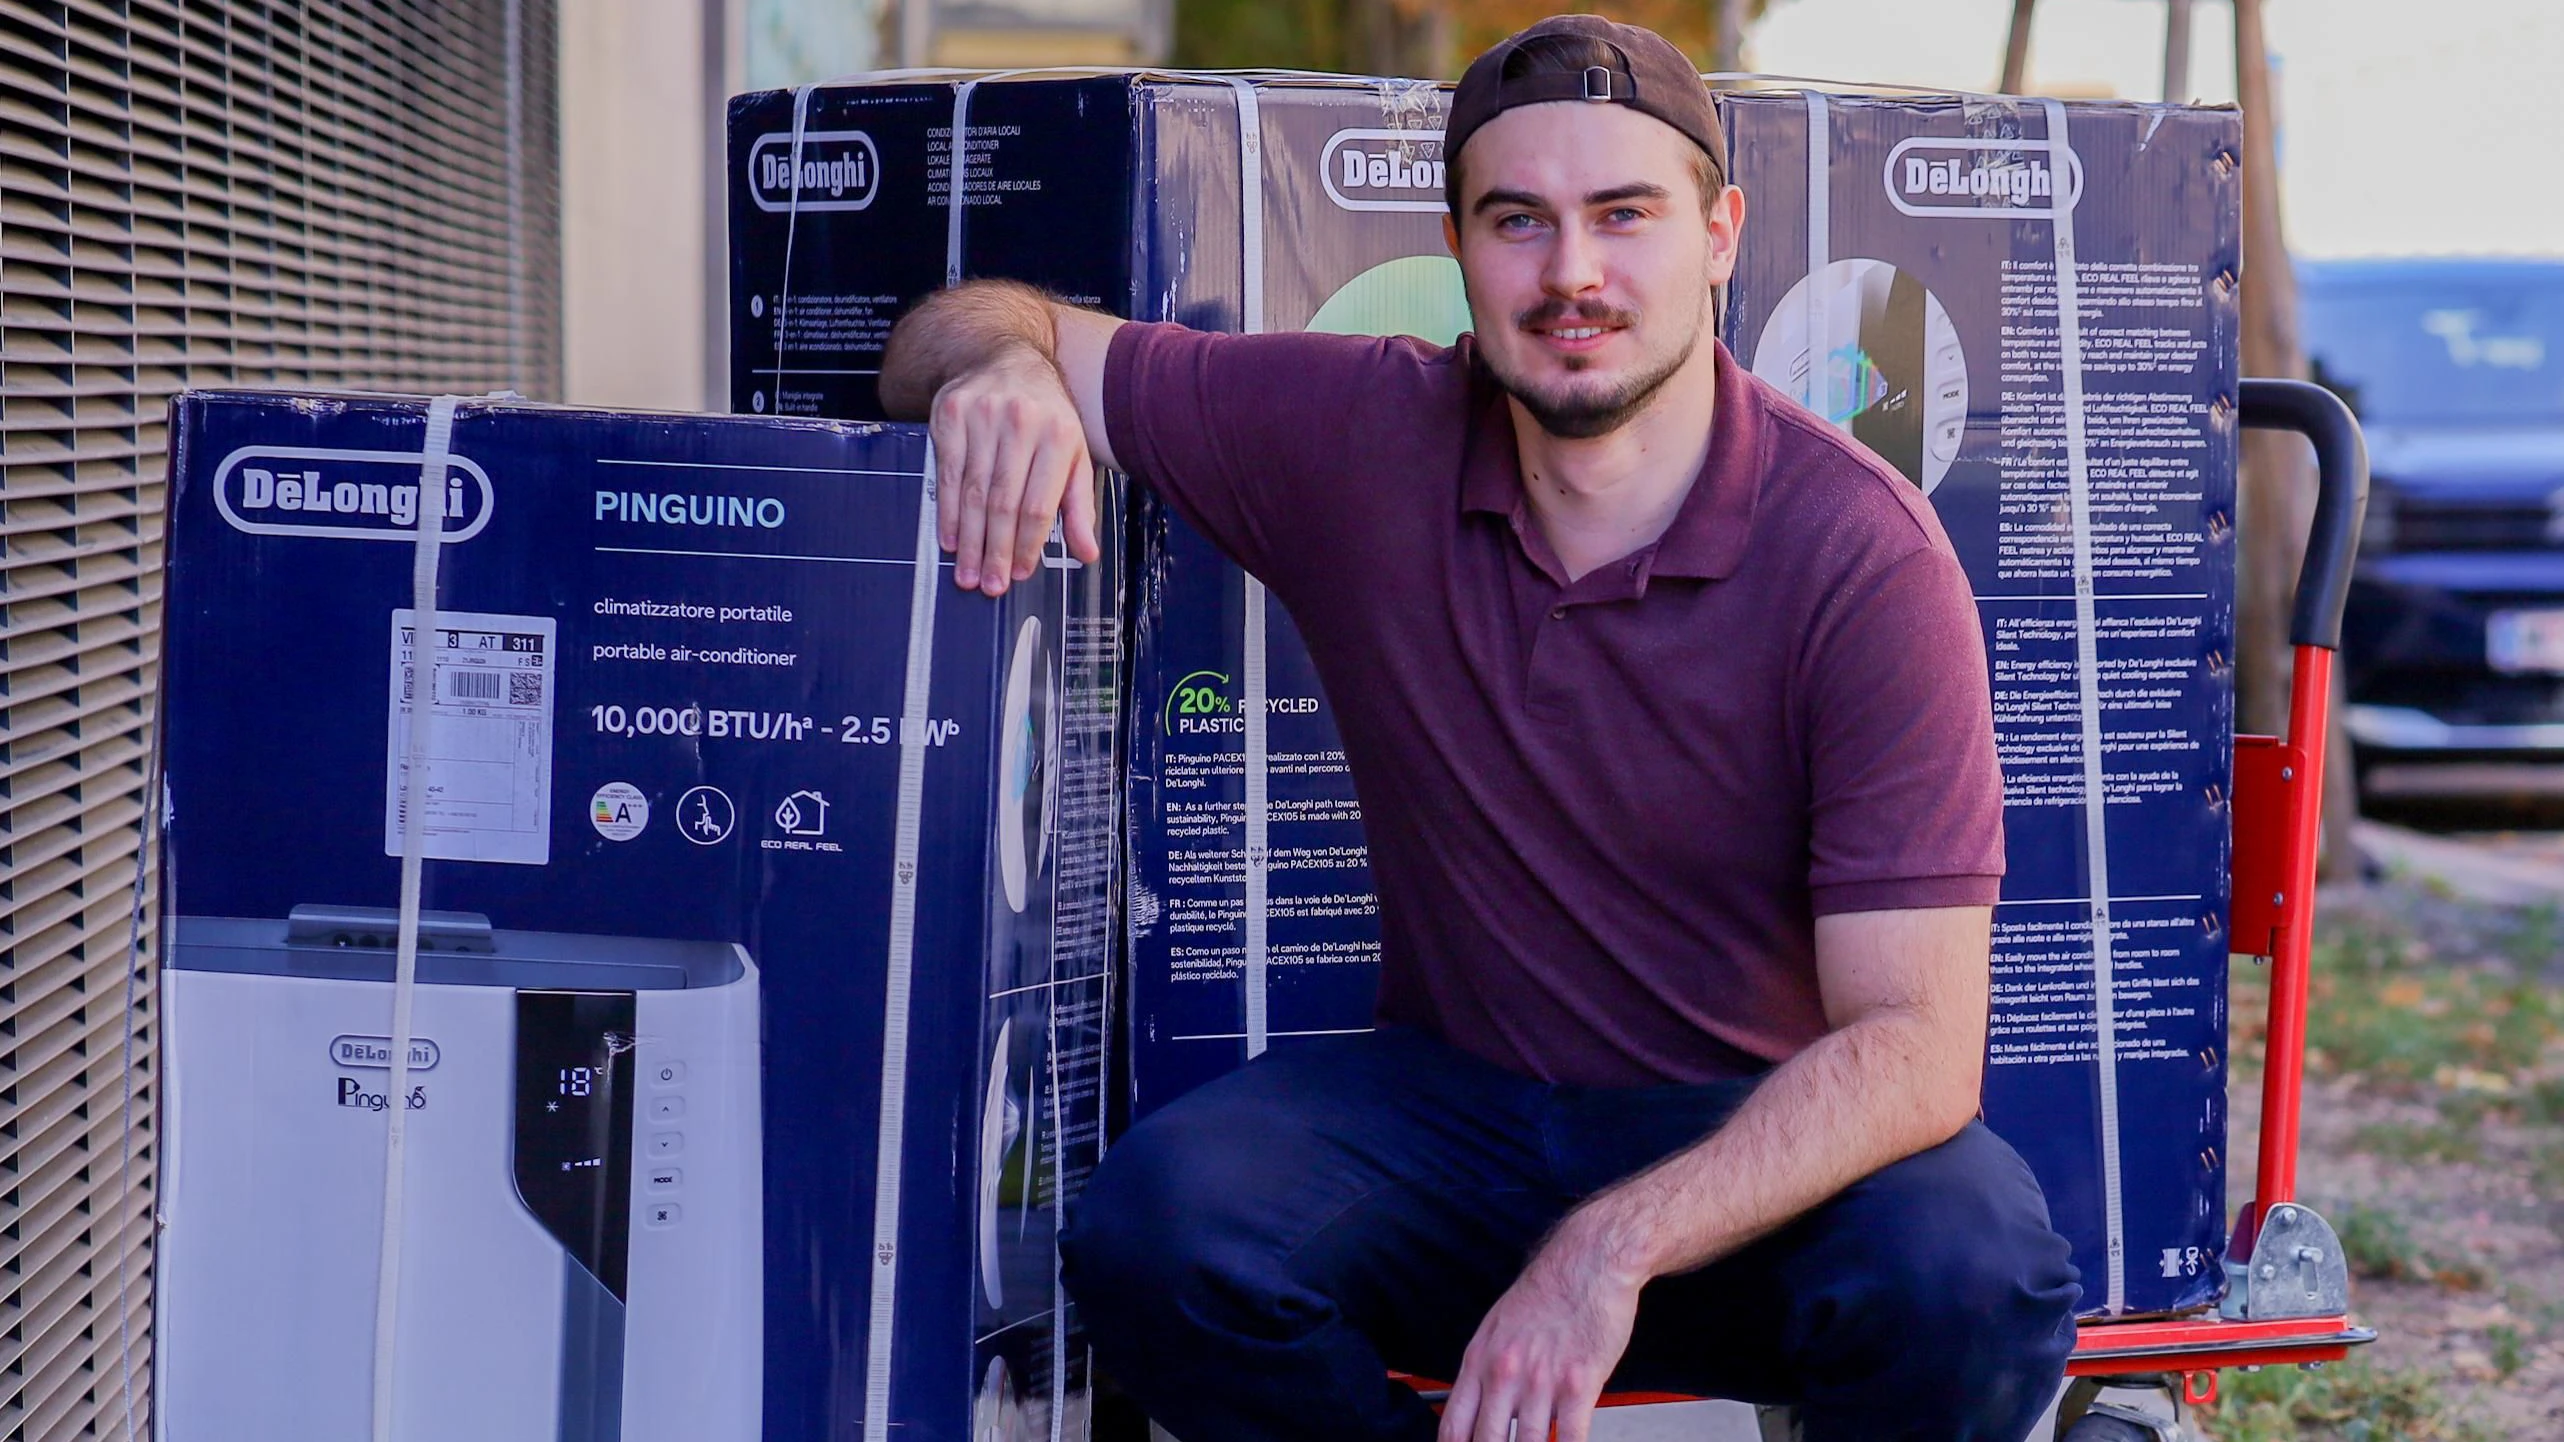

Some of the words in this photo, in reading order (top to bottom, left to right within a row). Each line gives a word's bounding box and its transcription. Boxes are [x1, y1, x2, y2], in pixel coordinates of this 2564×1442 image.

[928, 141, 947, 151] LOCAL
[1013, 180, 1041, 190] LOCALES
[983, 195, 1002, 204] LOCAL
[595, 491, 785, 528] PINGUINO
[594, 598, 715, 619] climatizzatore
[720, 605, 793, 623] portatile
[449, 634, 457, 646] 3
[479, 637, 495, 648] AT
[513, 638, 534, 651] 311
[593, 643, 666, 661] portable
[671, 645, 796, 666] air-conditioner
[1179, 687, 1230, 713] 20%
[592, 704, 702, 738] 10,000
[841, 716, 891, 743] 2.5
[1180, 718, 1245, 733] PLASTIC
[1165, 754, 1177, 763] IT:
[1178, 753, 1212, 764] Pinguino
[1213, 753, 1246, 763] PACEX1
[1304, 753, 1319, 761] con
[1326, 751, 1345, 761] 20%
[1165, 766, 1198, 776] riciclata:
[1200, 767, 1210, 775] un
[1212, 765, 1244, 775] ulteriore
[1270, 764, 1294, 773] avanti
[1295, 764, 1307, 773] nel
[1309, 764, 1344, 774] percorso
[1167, 803, 1181, 812] EN:
[1185, 802, 1196, 811] As
[1204, 801, 1231, 811] further
[1315, 799, 1333, 811] path
[1167, 814, 1219, 825] sustainability,
[1300, 811, 1306, 820] is
[1308, 811, 1330, 820] made
[1332, 810, 1348, 820] with
[1167, 827, 1201, 837] recycled
[1202, 826, 1229, 836] plastic.
[761, 839, 782, 849] ECO
[784, 840, 812, 851] REAL
[816, 841, 843, 852] FEEL
[1168, 850, 1183, 860] DE:
[1184, 850, 1197, 860] Als
[1198, 849, 1230, 859] weiterer
[1273, 848, 1291, 858] dem
[1293, 848, 1311, 859] Weg
[1312, 849, 1327, 857] von
[1168, 862, 1223, 873] Nachhaltigkeit
[1224, 861, 1246, 871] beste
[1291, 858, 1334, 869] PACEX105
[1335, 859, 1345, 868] zu
[1346, 858, 1358, 868] 20
[1360, 858, 1367, 867] %
[1168, 874, 1212, 885] recyceltem
[1170, 899, 1181, 909] FR
[1187, 899, 1217, 908] Comme
[1230, 899, 1244, 909] pas
[1275, 896, 1294, 906] dans
[1295, 896, 1302, 905] la
[1304, 895, 1321, 905] voie
[1322, 895, 1332, 905] de
[1169, 909, 1207, 921] durabilité,
[1208, 910, 1216, 920] le
[1297, 908, 1309, 917] est
[1310, 907, 1342, 918] fabriqué
[1344, 907, 1363, 916] avec
[1364, 906, 1376, 915] 20
[1169, 922, 1204, 934] plastique
[1206, 922, 1236, 932] recyclé.
[1170, 947, 1184, 957] ES:
[1186, 947, 1209, 957] Como
[1211, 948, 1220, 956] un
[1222, 947, 1240, 957] paso
[1271, 943, 1280, 952] el
[1281, 942, 1309, 952] camino
[1310, 942, 1320, 951] de
[1170, 958, 1224, 970] sostenibilidad,
[1266, 955, 1304, 965] ACEX105
[1305, 956, 1315, 964] se
[1316, 954, 1343, 964] fabrica
[1344, 954, 1359, 963] con
[1360, 954, 1371, 963] un
[1170, 970, 1201, 983] plástico
[1202, 969, 1239, 980] reciclado.
[653, 1176, 673, 1184] MODE
